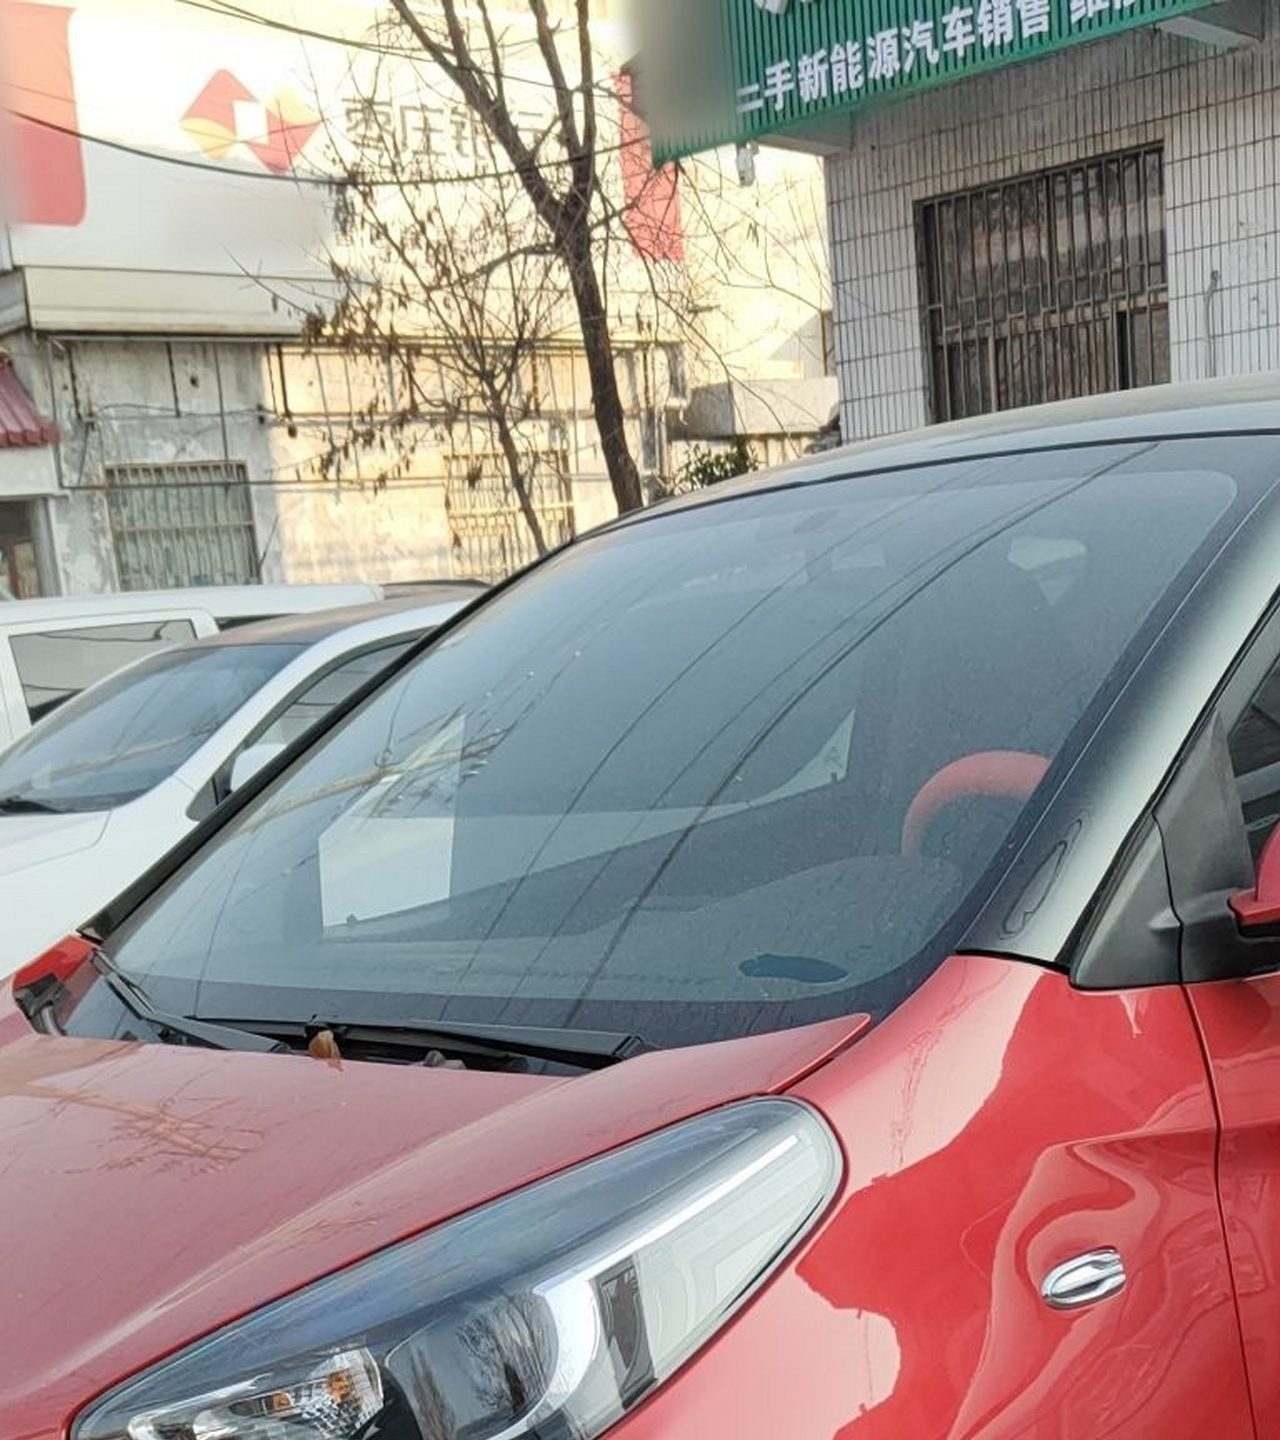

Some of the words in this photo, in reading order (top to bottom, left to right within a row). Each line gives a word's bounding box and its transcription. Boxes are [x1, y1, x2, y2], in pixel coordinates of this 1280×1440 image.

[736, 0, 1050, 112] 二手新能源汽车销售
